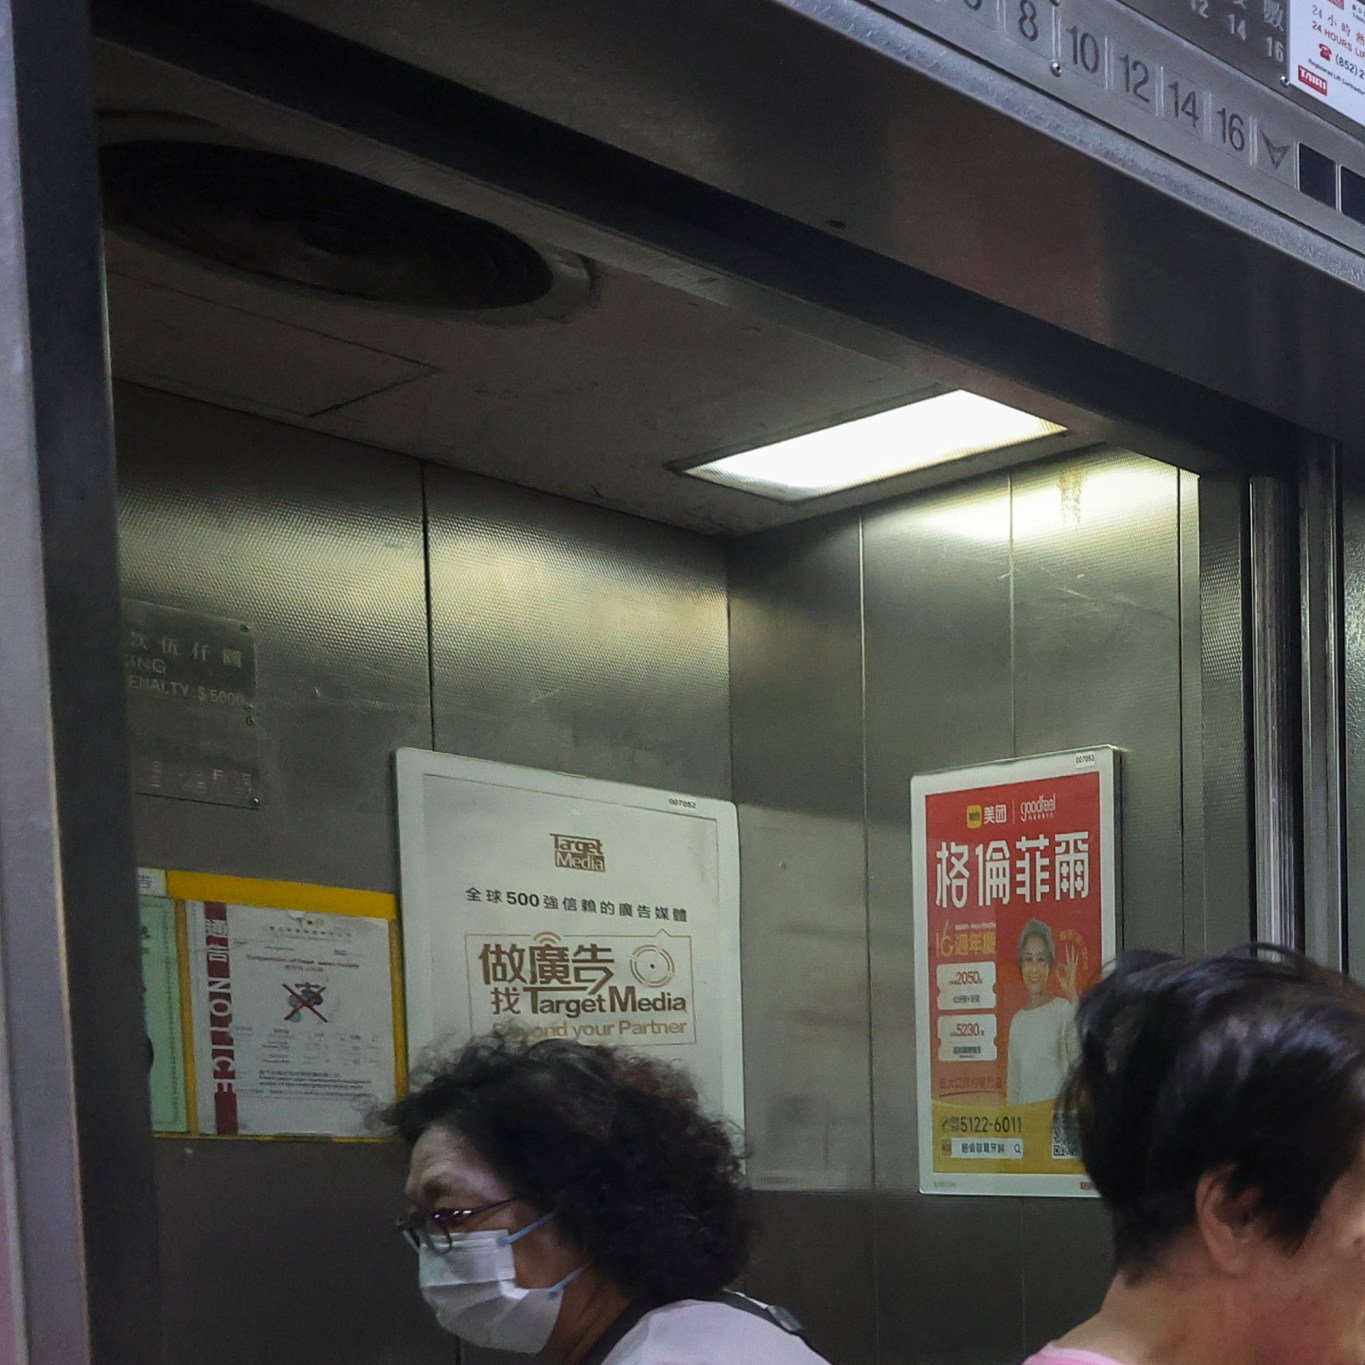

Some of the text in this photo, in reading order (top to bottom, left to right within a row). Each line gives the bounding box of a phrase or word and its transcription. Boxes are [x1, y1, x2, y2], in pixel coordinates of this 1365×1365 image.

[1265, 36, 1285, 62] 16
[1312, 20, 1323, 34] 24
[1324, 26, 1353, 53] HOURS
[1335, 53, 1358, 76] (852)
[1067, 25, 1099, 74] 10
[1119, 54, 1151, 103] 12
[1169, 80, 1199, 128] 14
[1217, 107, 1246, 152] 16
[984, 804, 1007, 825] 美团
[550, 832, 603, 855] Target
[556, 852, 604, 872] Media
[935, 830, 1089, 909] 格倫菲爾
[465, 886, 688, 923] 全球500強信賴的廣告媒體
[478, 942, 615, 992] 做廣告
[490, 984, 688, 1019] 找 Target Media
[208, 977, 236, 1093] NOTICE
[573, 1023, 614, 1041] your
[618, 1019, 688, 1036] Partner
[960, 1116, 1022, 1134] 5122-6011
